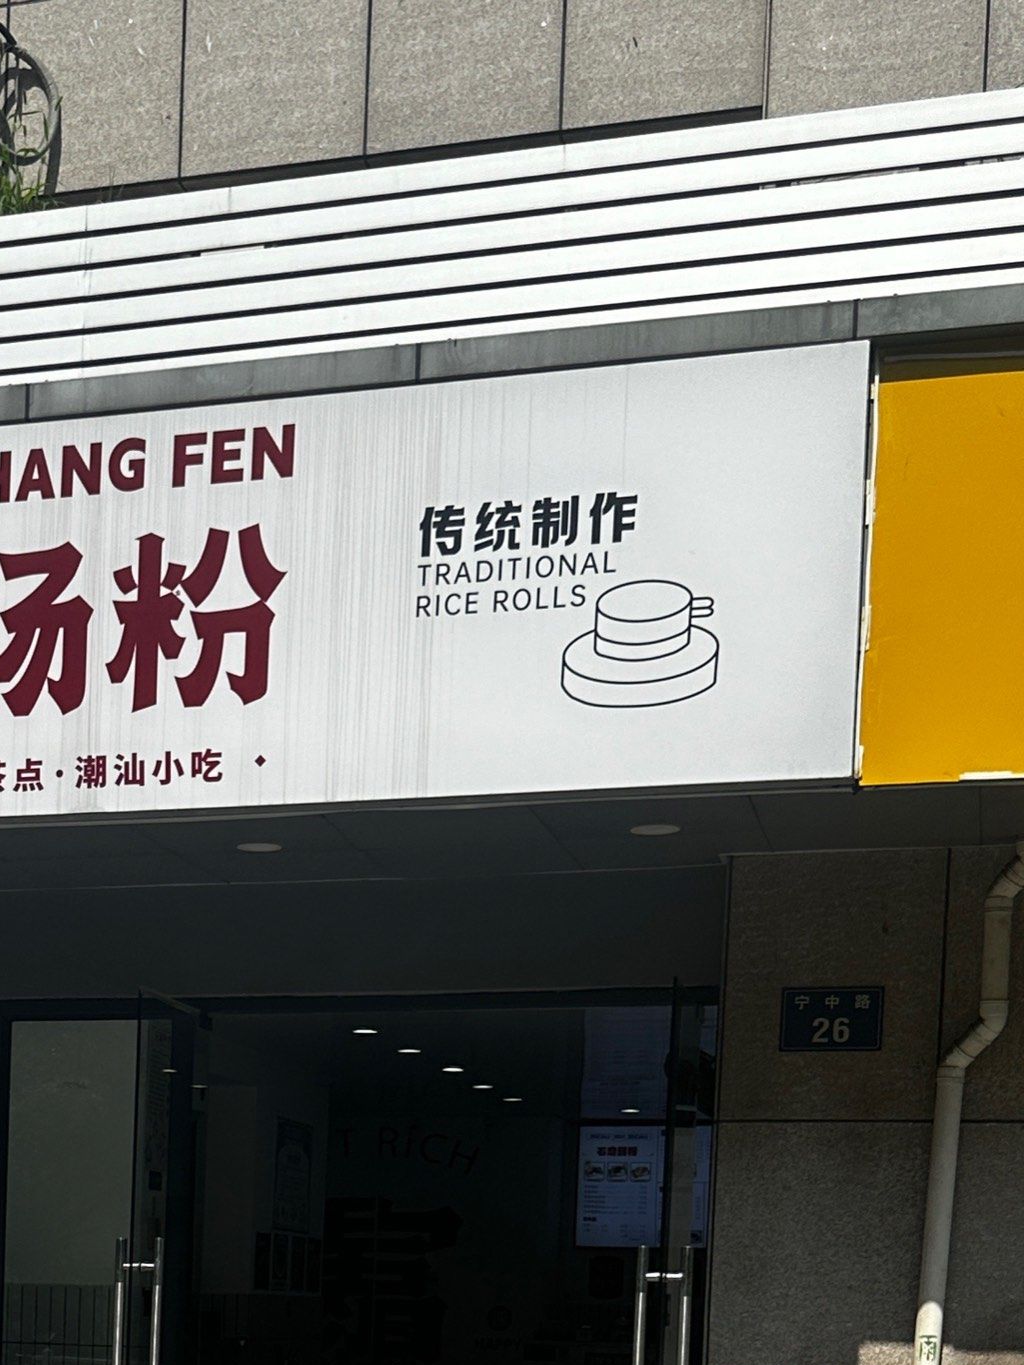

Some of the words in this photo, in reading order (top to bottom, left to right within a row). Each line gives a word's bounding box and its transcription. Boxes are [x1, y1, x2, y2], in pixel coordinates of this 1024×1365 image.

[172, 424, 295, 488] FEN
[419, 491, 638, 558] 传统制作
[418, 550, 617, 587] TRADITIONAL
[416, 592, 479, 618] RICE
[493, 584, 587, 613] ROLLS
[794, 994, 871, 1010] 宁中路
[811, 1017, 850, 1044] 26
[919, 1335, 938, 1361] 雨
